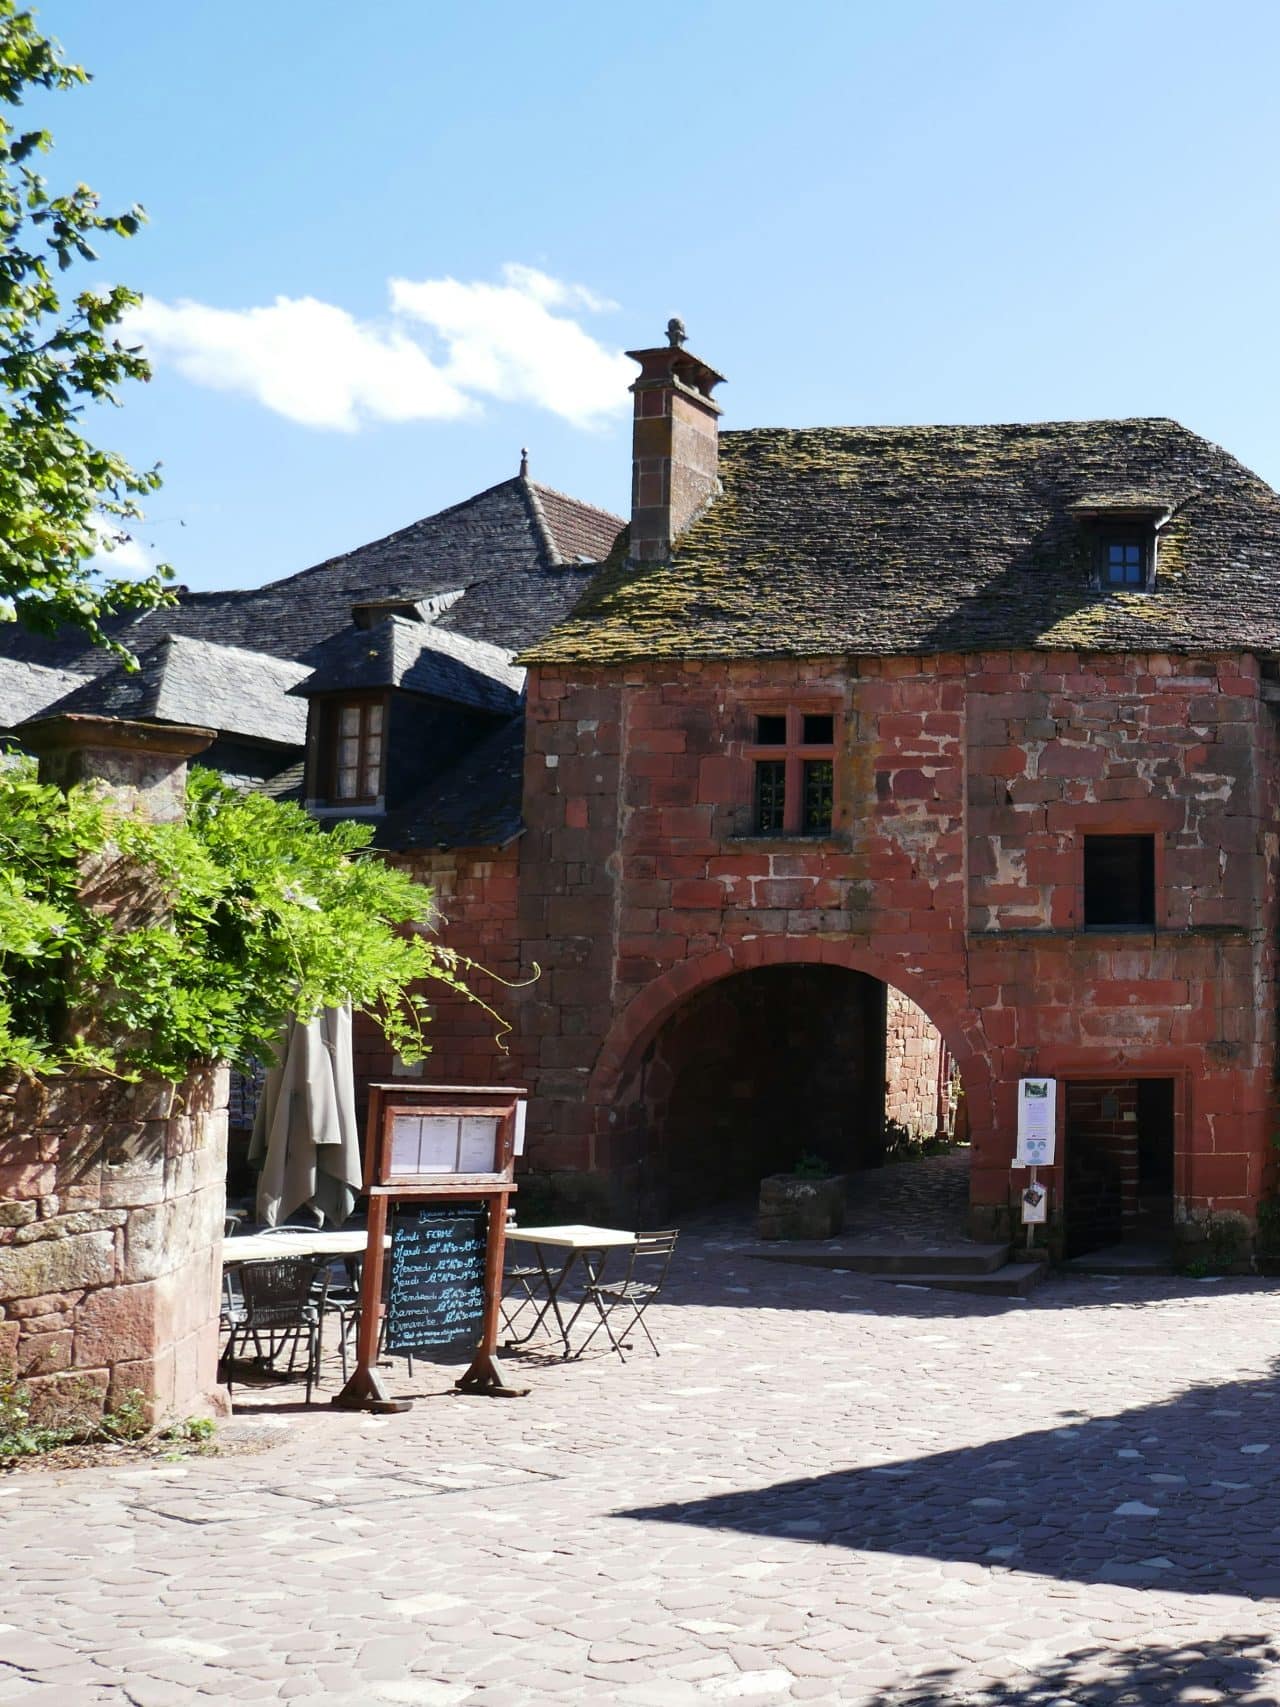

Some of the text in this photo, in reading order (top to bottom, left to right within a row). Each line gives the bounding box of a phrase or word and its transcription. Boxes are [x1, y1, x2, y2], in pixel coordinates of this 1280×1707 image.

[395, 1228, 419, 1242] Lundi
[393, 1244, 420, 1258] Mardi
[393, 1274, 419, 1290] Jeudi
[389, 1304, 429, 1319] Samedi
[389, 1316, 438, 1333] Dimanche
